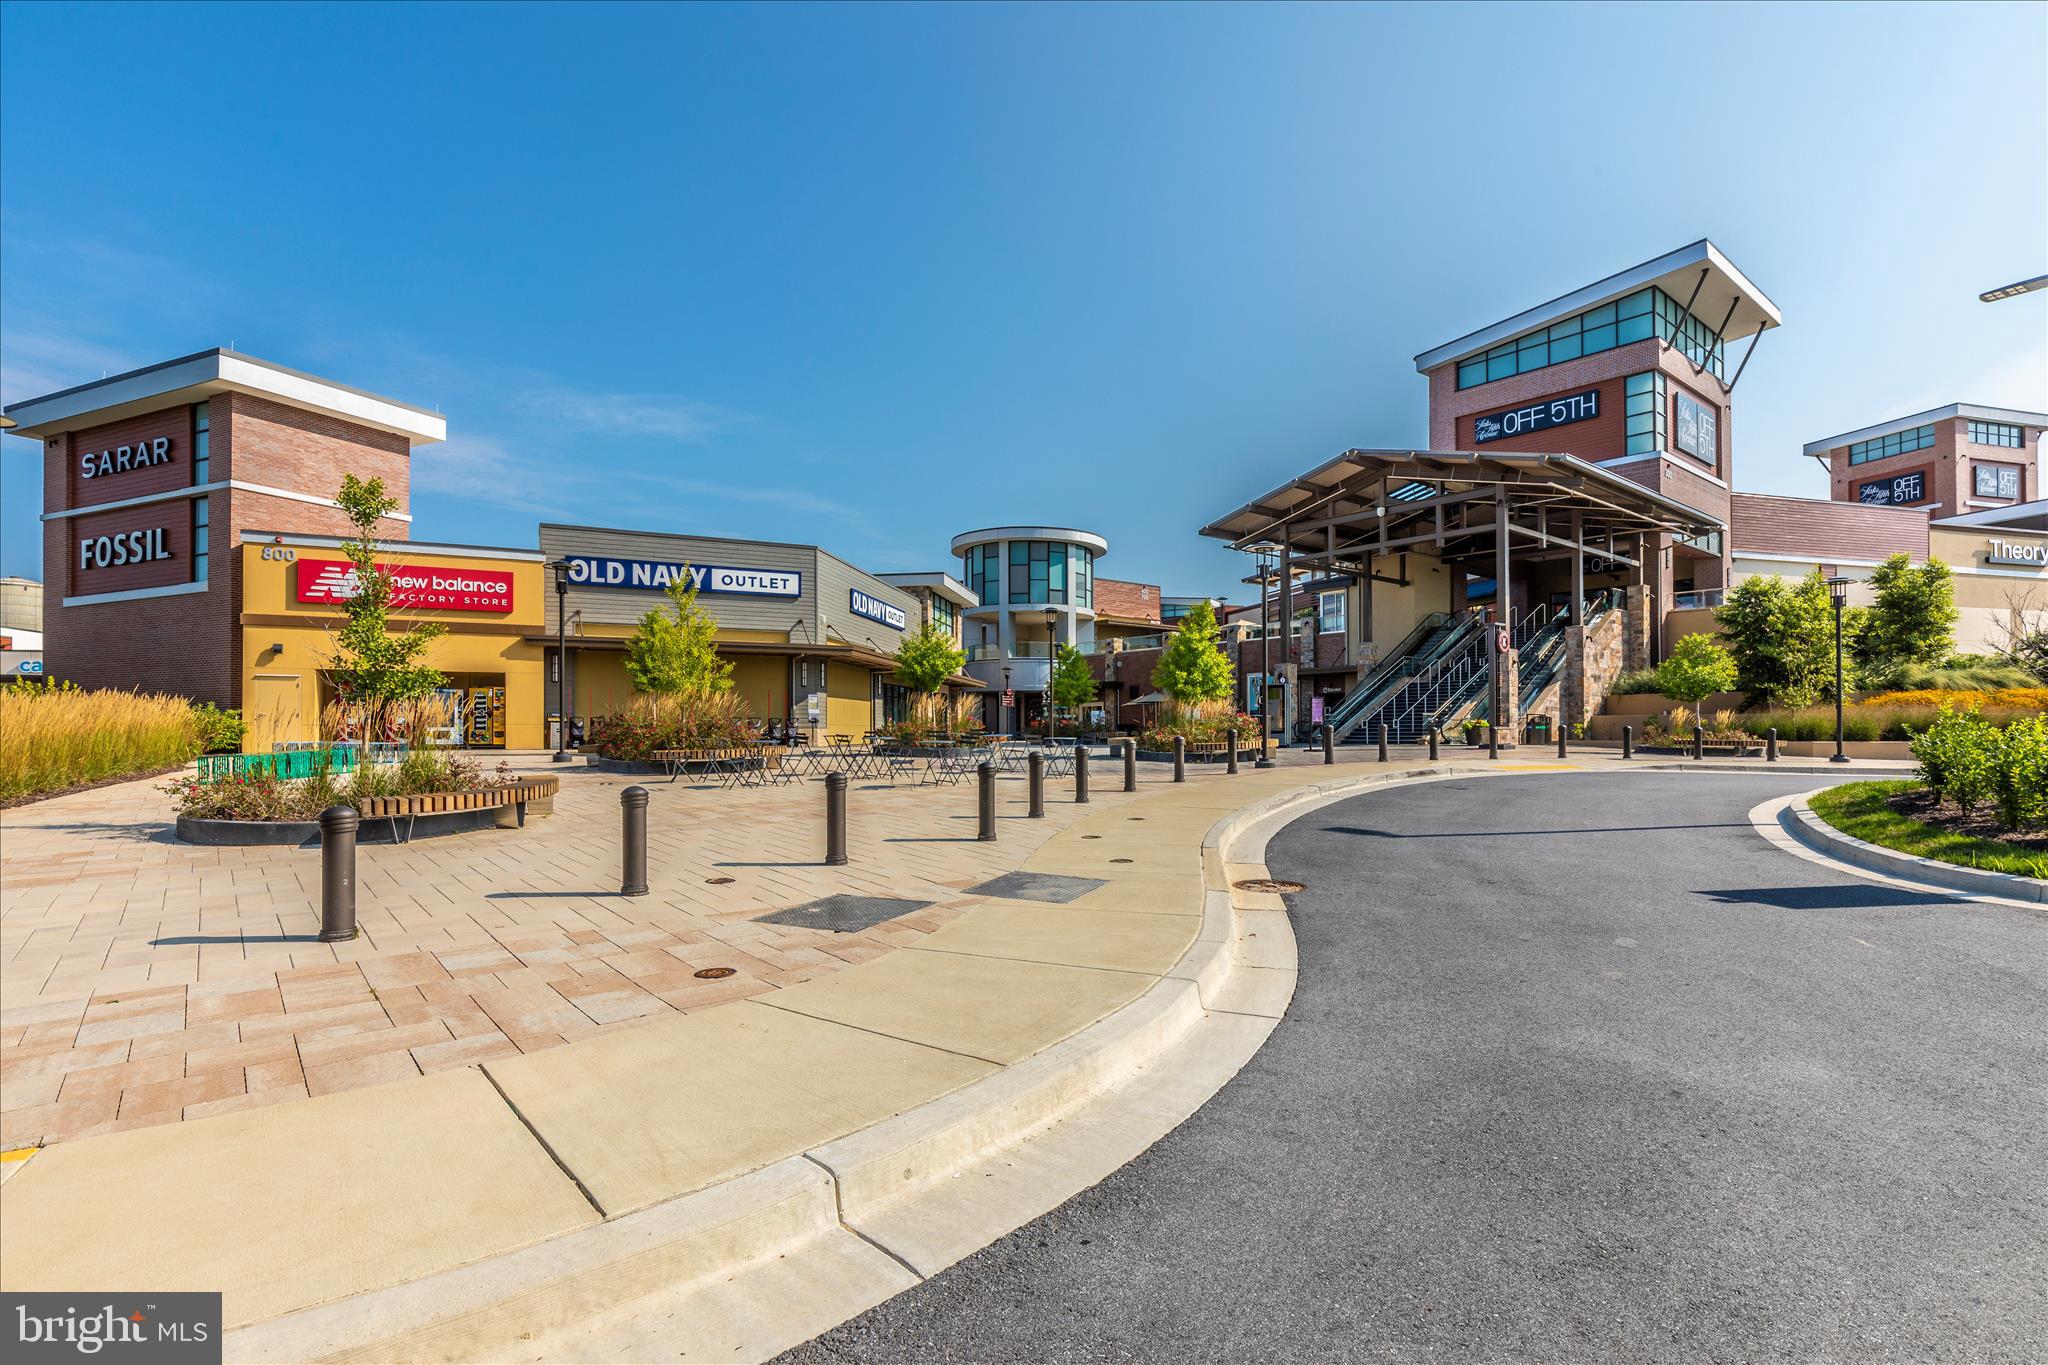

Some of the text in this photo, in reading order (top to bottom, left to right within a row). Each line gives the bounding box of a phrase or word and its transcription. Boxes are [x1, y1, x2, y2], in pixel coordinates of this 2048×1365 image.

[1503, 393, 1596, 434] OFF 5TH
[1699, 412, 1714, 437] OFF
[1699, 433, 1714, 458] 5TH
[81, 436, 170, 479] SARAR
[1893, 474, 1920, 491] OFF
[1999, 471, 2017, 484] OFF
[1893, 486, 1920, 502] 5TH
[1999, 483, 2017, 495] 5TH
[261, 546, 296, 562] 800
[1988, 538, 2048, 565] Theory
[568, 558, 707, 590] OLD NAVY
[721, 574, 790, 590] OUTLET
[389, 574, 507, 594] new balance
[389, 592, 508, 606] FACTORY STORE
[853, 591, 886, 620] OLD NAVY
[887, 609, 903, 624] OUTLET
